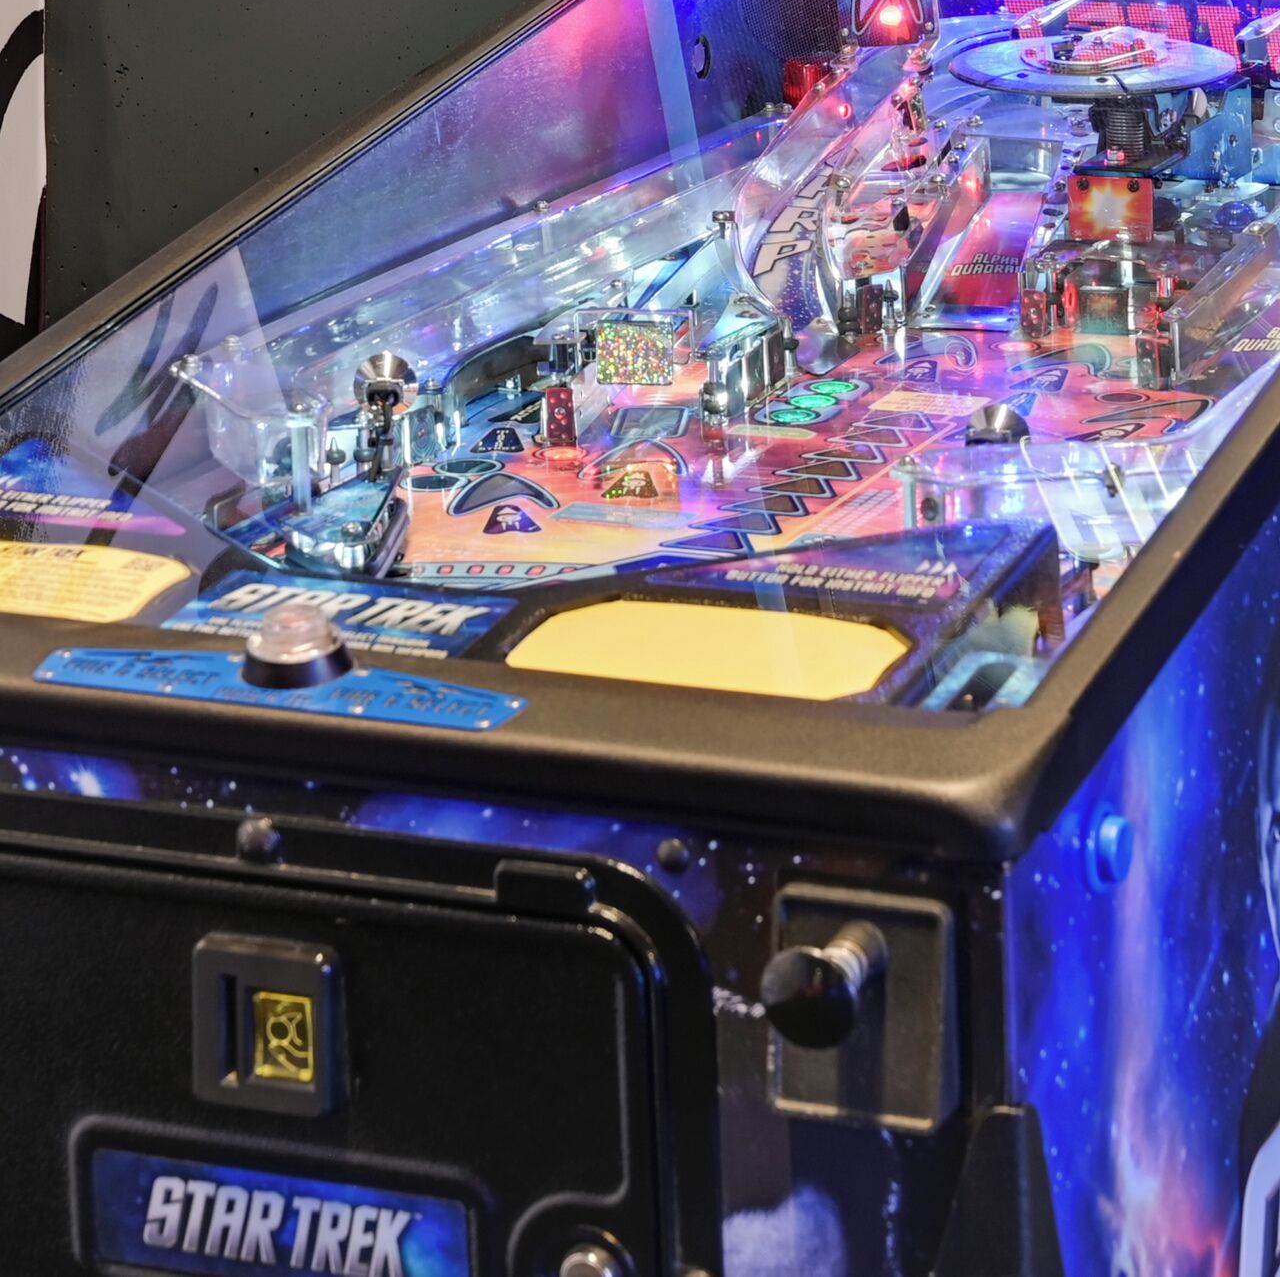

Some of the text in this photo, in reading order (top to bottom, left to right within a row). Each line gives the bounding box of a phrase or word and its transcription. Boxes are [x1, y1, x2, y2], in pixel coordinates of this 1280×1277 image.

[950, 264, 1021, 276] QUADRA
[972, 253, 1019, 265] ALPHA
[208, 582, 372, 625] STAR
[346, 596, 492, 637] TREK
[143, 1175, 413, 1277] STAR TREK
